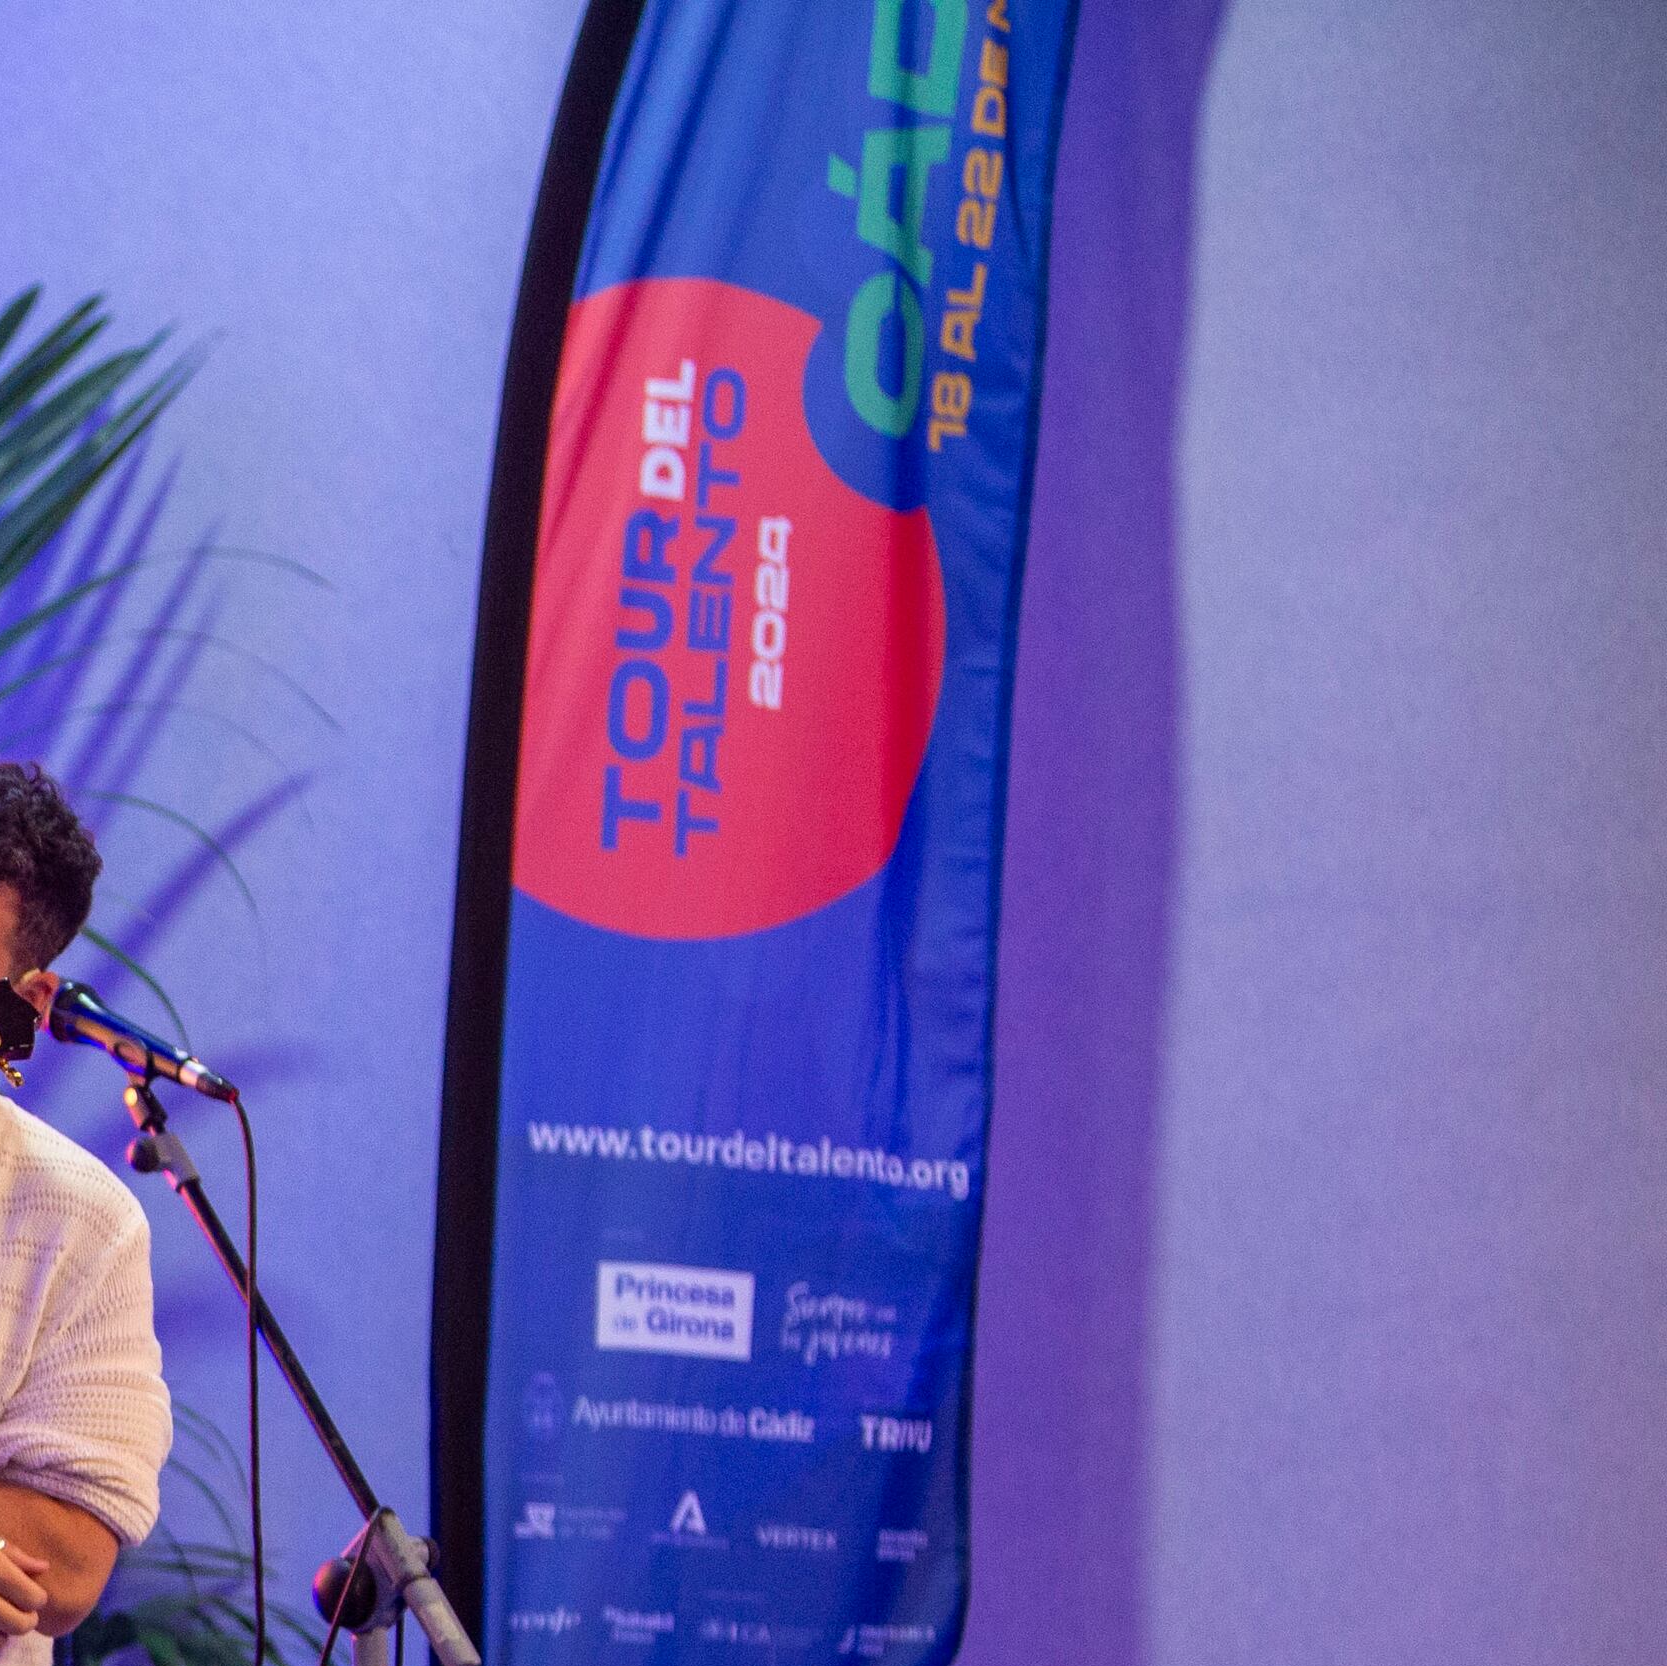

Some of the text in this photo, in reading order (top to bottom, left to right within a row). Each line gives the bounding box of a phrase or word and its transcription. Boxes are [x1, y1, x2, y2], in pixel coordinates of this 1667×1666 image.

[971, 37, 1010, 138] DE
[827, 0, 967, 439] CÁD
[955, 147, 1005, 250] 22
[939, 263, 989, 363] AL
[927, 370, 973, 453] 18
[600, 358, 697, 852] TOUR DEL
[673, 366, 747, 857] TALENTO
[749, 516, 793, 710] 2024
[528, 1119, 969, 1200] www.tourdeltalento.org
[613, 1271, 736, 1310] Princesa
[645, 1306, 735, 1342] Girona
